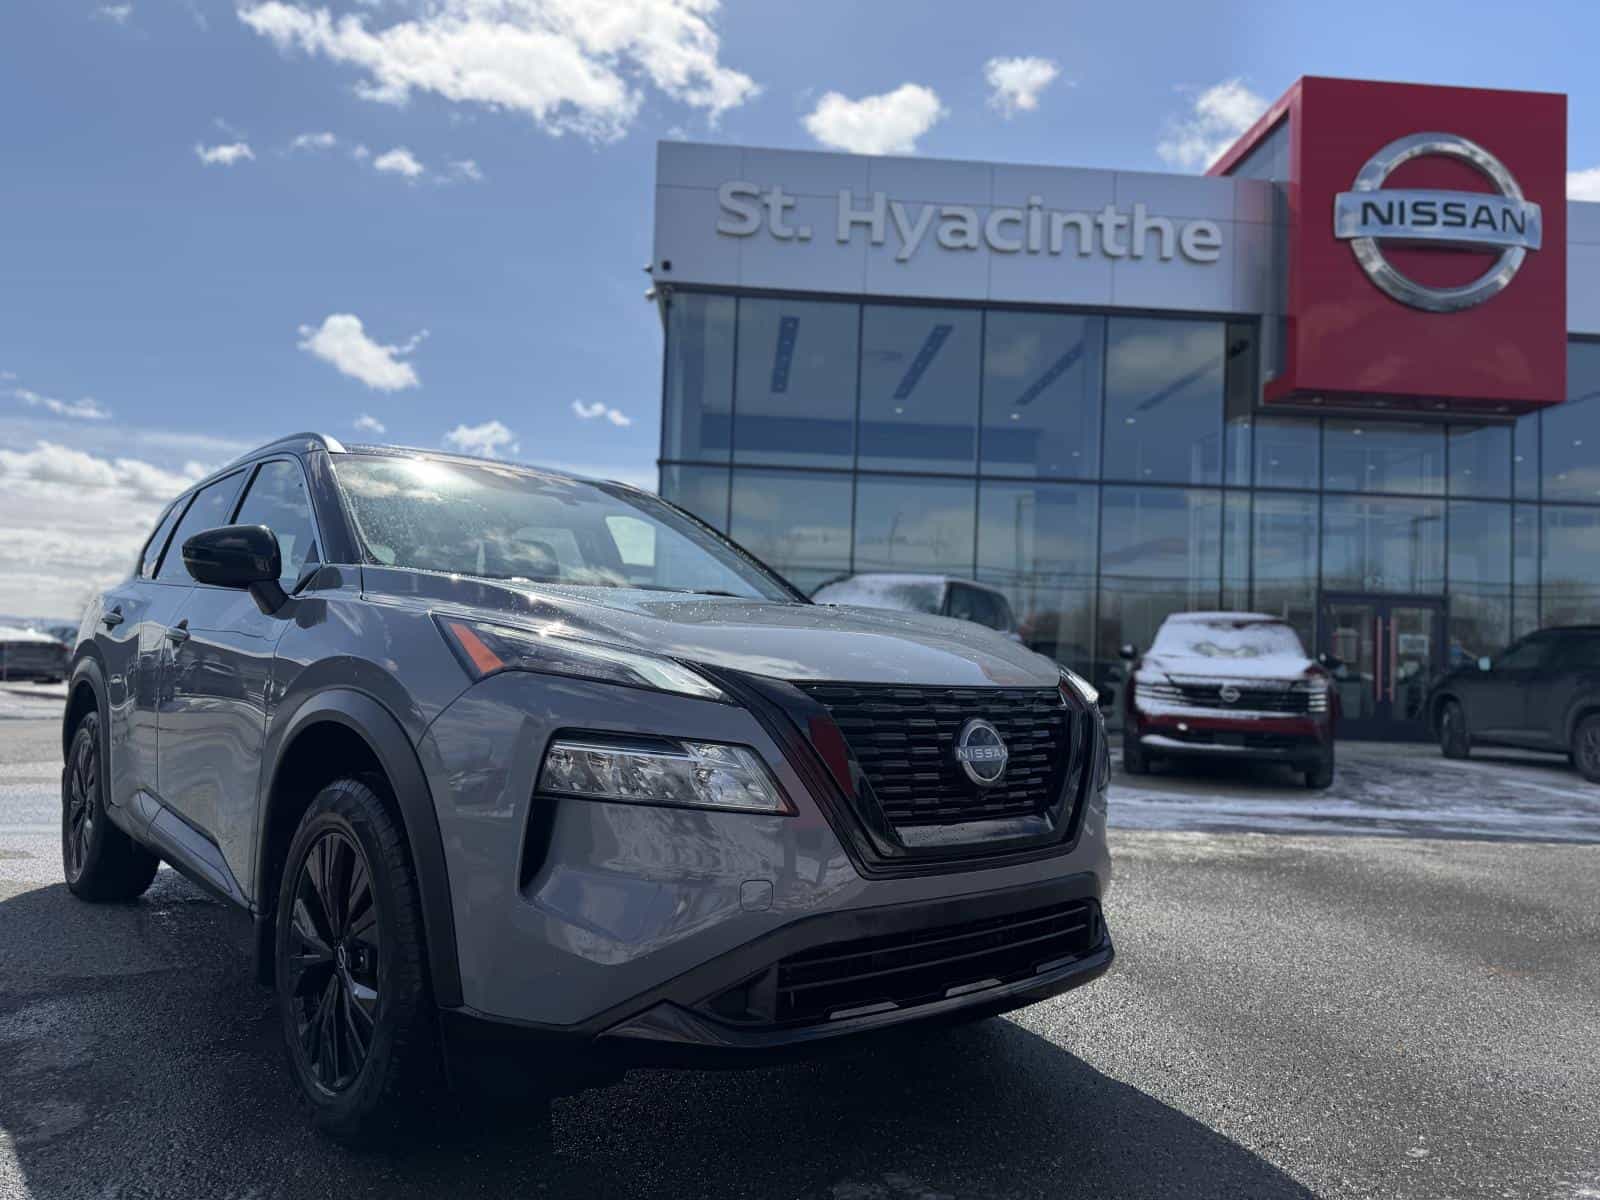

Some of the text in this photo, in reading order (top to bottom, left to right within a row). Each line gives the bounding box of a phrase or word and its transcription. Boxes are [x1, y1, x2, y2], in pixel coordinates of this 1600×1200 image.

[716, 180, 1223, 264] St. Hyacinthe
[1361, 200, 1526, 235] NISSAN
[957, 748, 1008, 760] NISSAN
